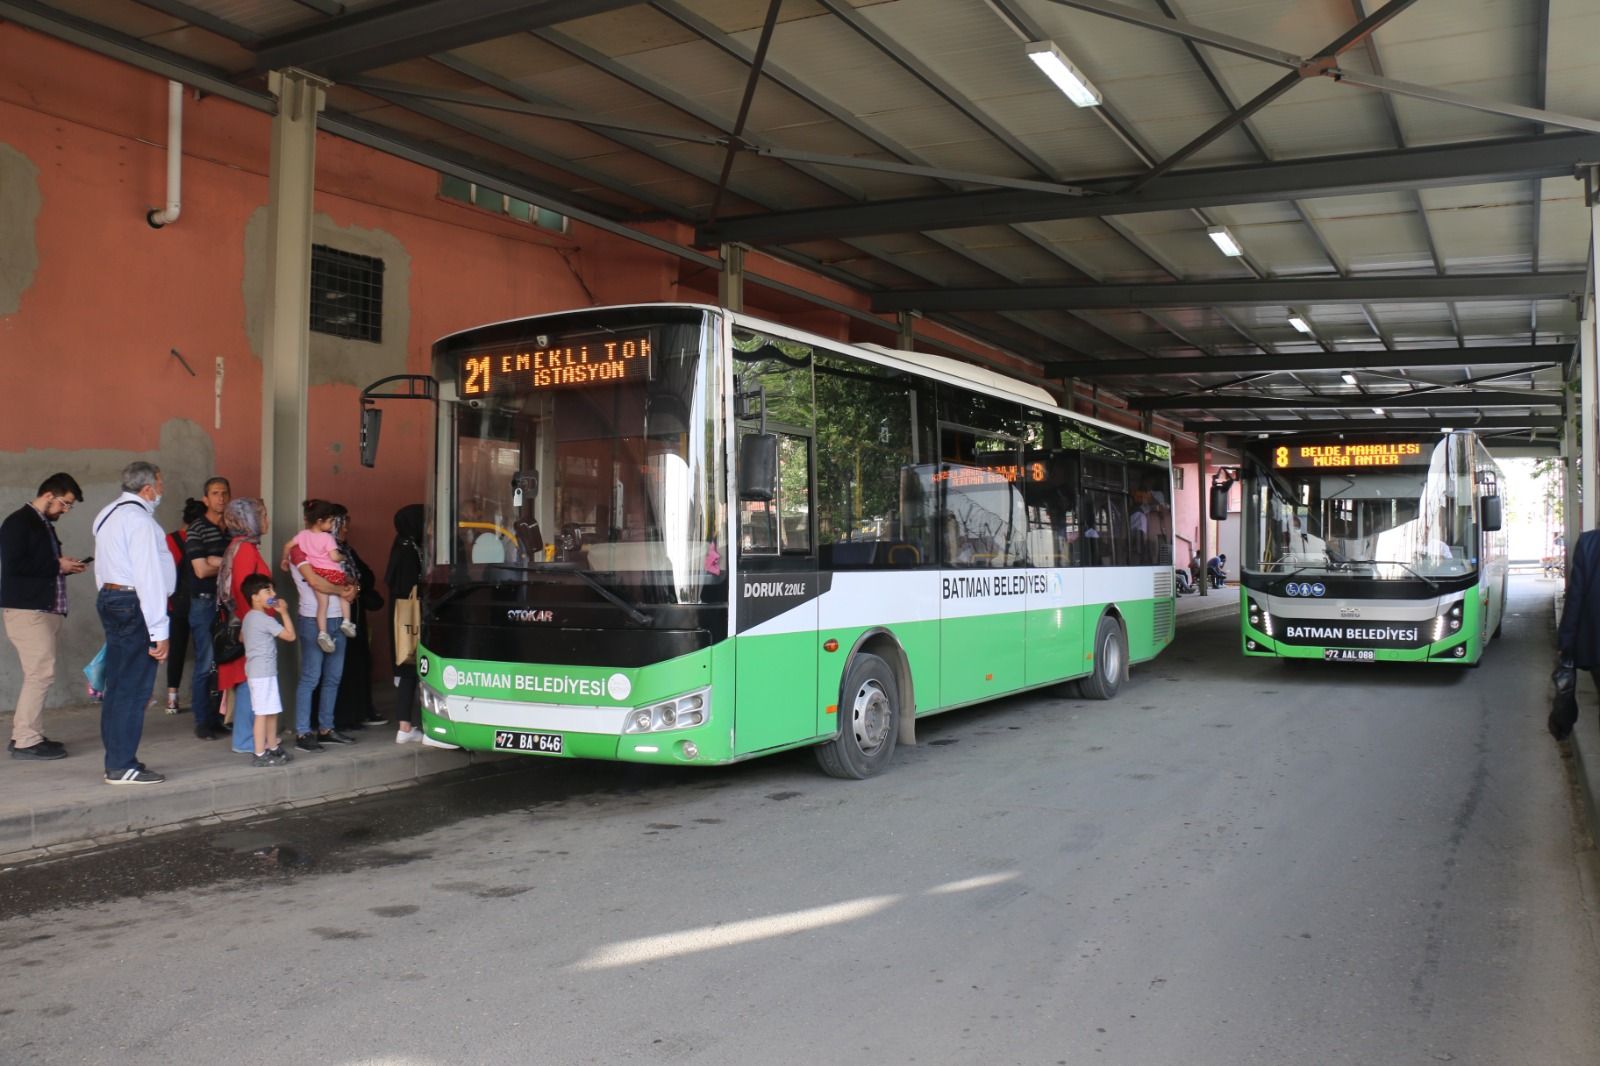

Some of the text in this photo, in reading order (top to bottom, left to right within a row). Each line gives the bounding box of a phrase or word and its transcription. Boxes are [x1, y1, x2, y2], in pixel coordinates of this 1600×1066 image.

[465, 356, 491, 393] 21
[1276, 446, 1289, 467] 8
[1301, 446, 1341, 457] BELDE
[1313, 454, 1399, 466] MUSA ANTER
[743, 581, 806, 598] DORUK 220LE
[942, 571, 1048, 600] BATMAN BELEDİYESİ
[507, 609, 554, 623] OTOKAR
[1286, 626, 1418, 641] BATMAN BELEDİYESİ
[1327, 649, 1338, 658] 72
[1342, 650, 1357, 659] AAL
[457, 671, 606, 697] BATMAN BELEDİYESİ
[500, 733, 561, 751] 72 BA 646
